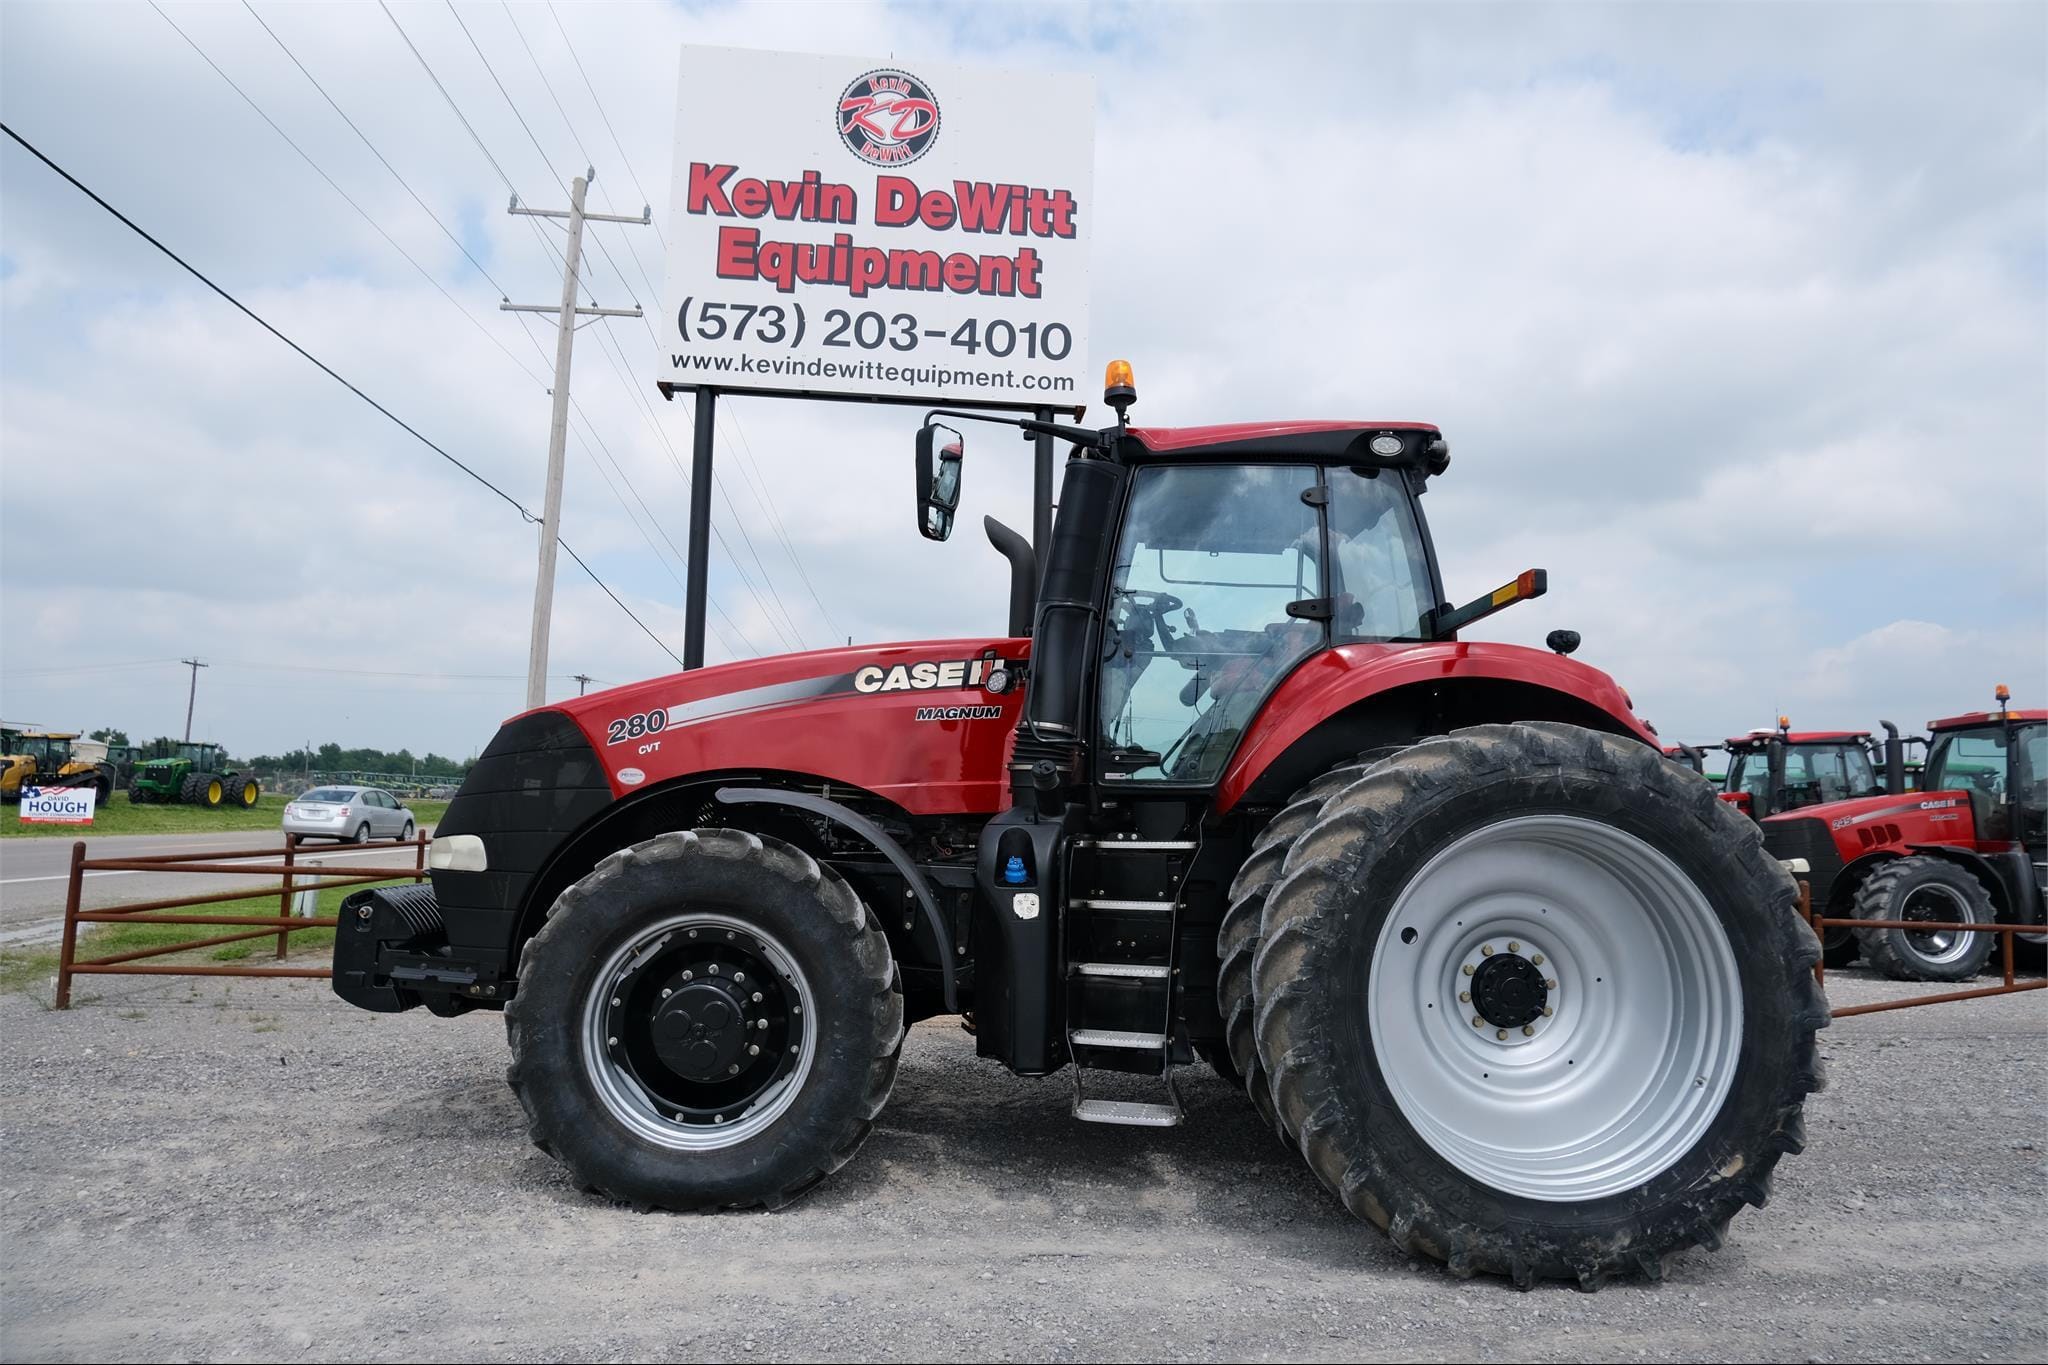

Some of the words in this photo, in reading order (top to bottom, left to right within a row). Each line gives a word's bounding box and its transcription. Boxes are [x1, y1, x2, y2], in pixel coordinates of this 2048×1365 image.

[868, 76, 912, 95] Kevin
[840, 96, 938, 140] KD
[860, 141, 914, 162] DeWitt
[687, 162, 857, 226] Kevin
[874, 174, 1078, 240] DeWitt
[716, 225, 1043, 299] Equipment
[677, 296, 807, 349] (573)
[821, 308, 1073, 361] 203-4010
[671, 353, 1074, 391] www.kevindewittequipment.com
[854, 661, 966, 693] CASE
[607, 708, 667, 746] 280
[915, 706, 1002, 721] MAGNUM
[638, 741, 661, 755] CVT
[29, 801, 87, 812] HOUGH
[1920, 800, 1946, 809] CASE
